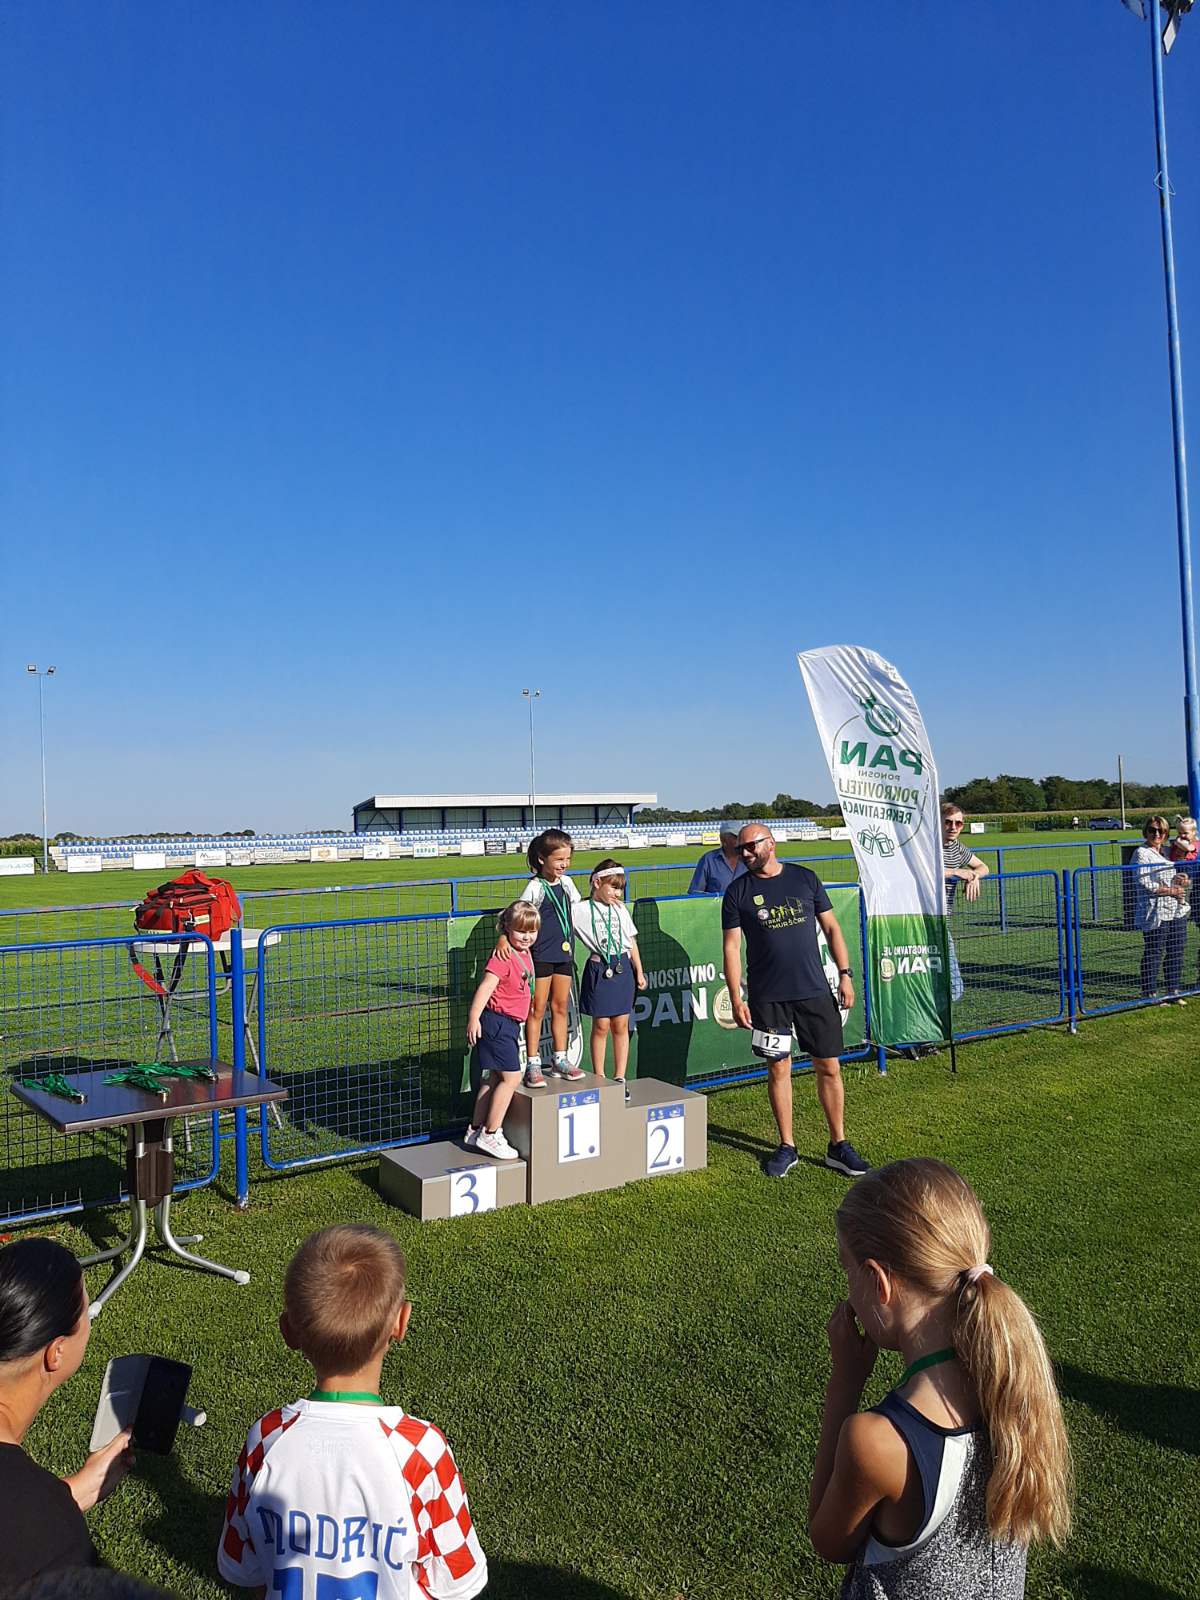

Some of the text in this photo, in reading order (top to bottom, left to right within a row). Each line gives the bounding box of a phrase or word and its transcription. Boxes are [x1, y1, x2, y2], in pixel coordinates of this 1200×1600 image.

[628, 986, 709, 1032] PAN
[763, 1035, 780, 1049] 12
[563, 1112, 595, 1159] 1.
[649, 1124, 683, 1169] 2.
